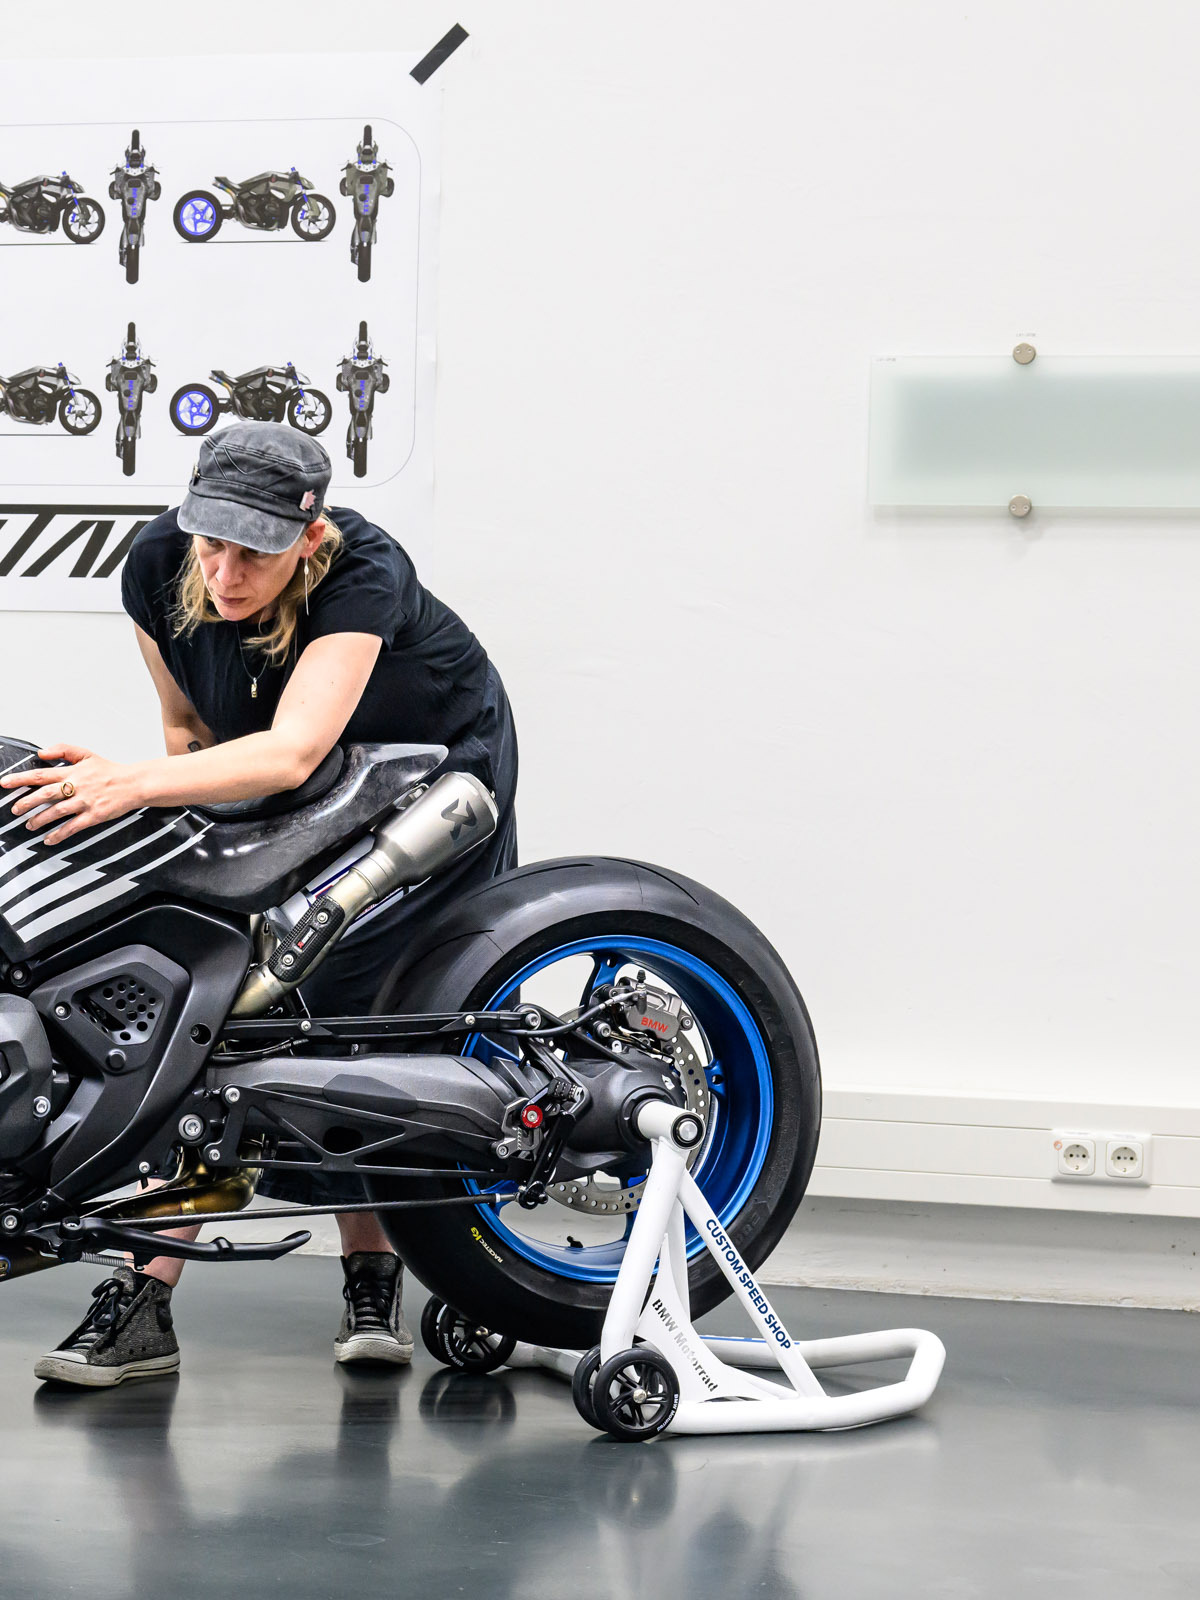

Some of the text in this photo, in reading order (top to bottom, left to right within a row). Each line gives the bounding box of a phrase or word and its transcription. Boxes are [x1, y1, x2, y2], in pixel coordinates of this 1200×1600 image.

[641, 1016, 669, 1033] BMW
[706, 1219, 744, 1275] CUSTOM
[738, 1272, 769, 1315] SPEED
[764, 1313, 791, 1349] SHOP
[652, 1299, 718, 1392] BMW Motorrad
